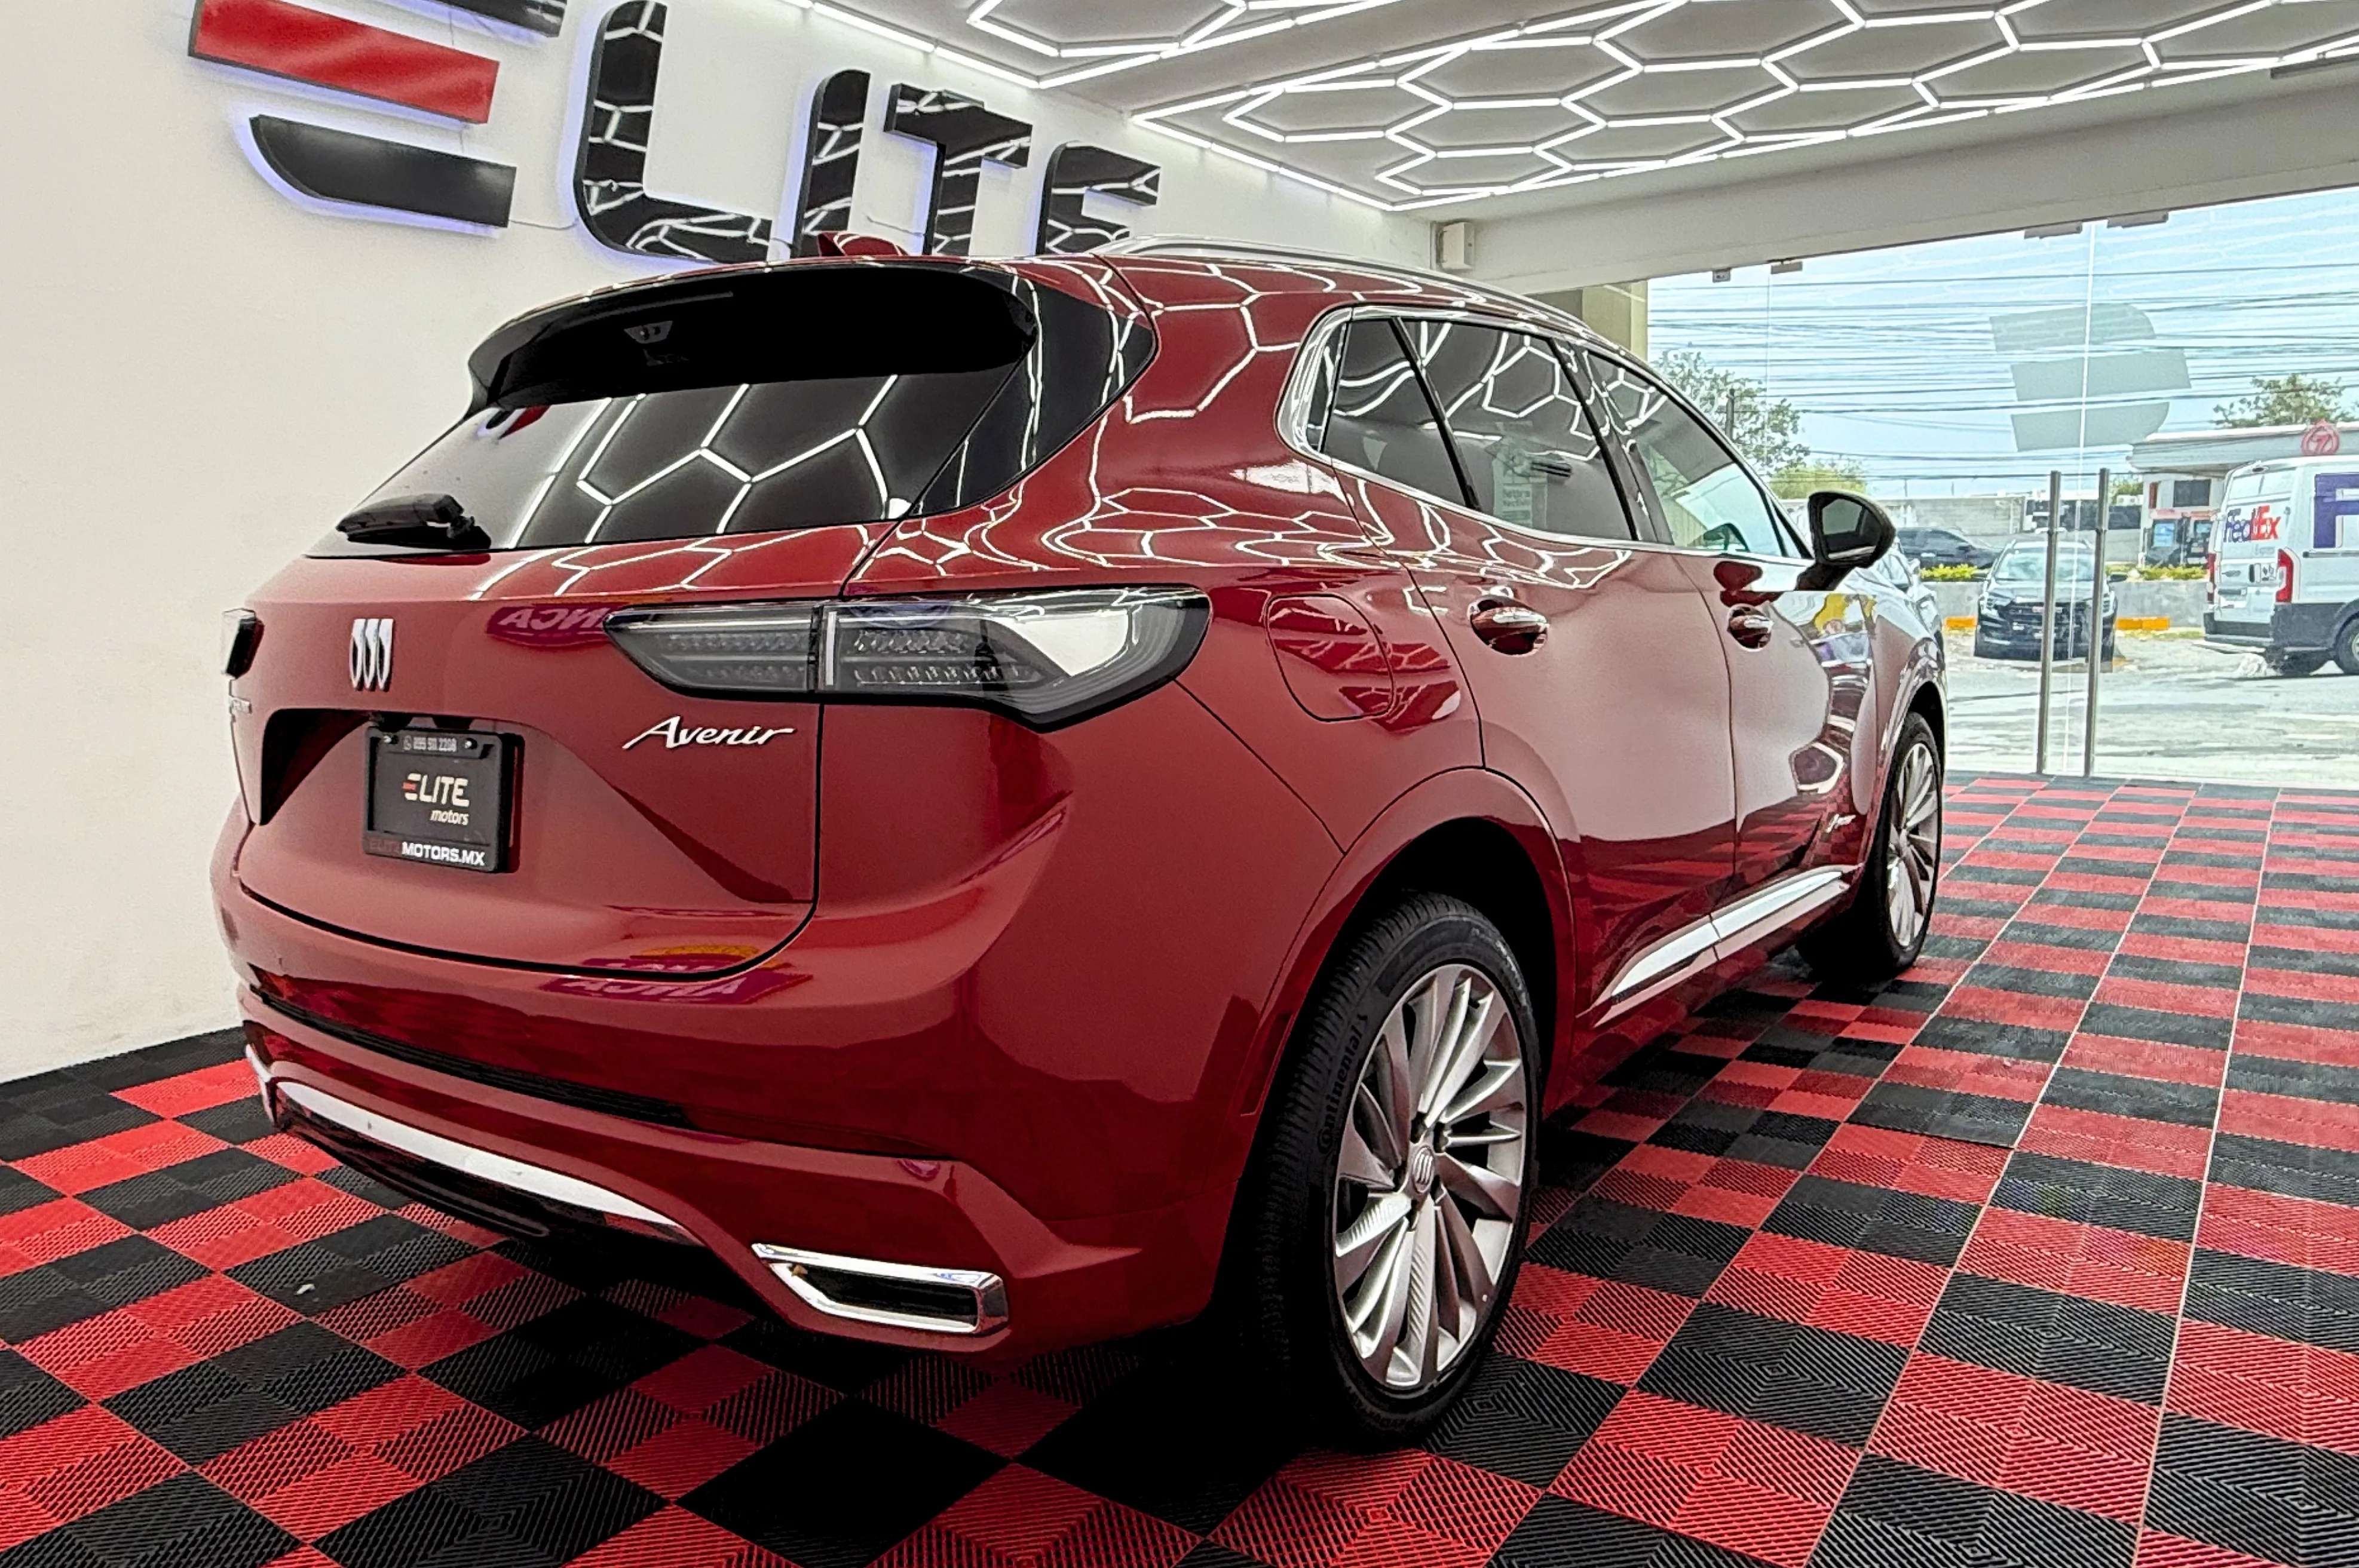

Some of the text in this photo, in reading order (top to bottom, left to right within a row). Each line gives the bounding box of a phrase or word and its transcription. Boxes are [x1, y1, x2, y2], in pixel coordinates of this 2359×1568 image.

[2223, 505, 2281, 542] FedEx
[622, 716, 795, 750] Avenir
[402, 773, 470, 807] ELITE
[430, 809, 469, 826] motors
